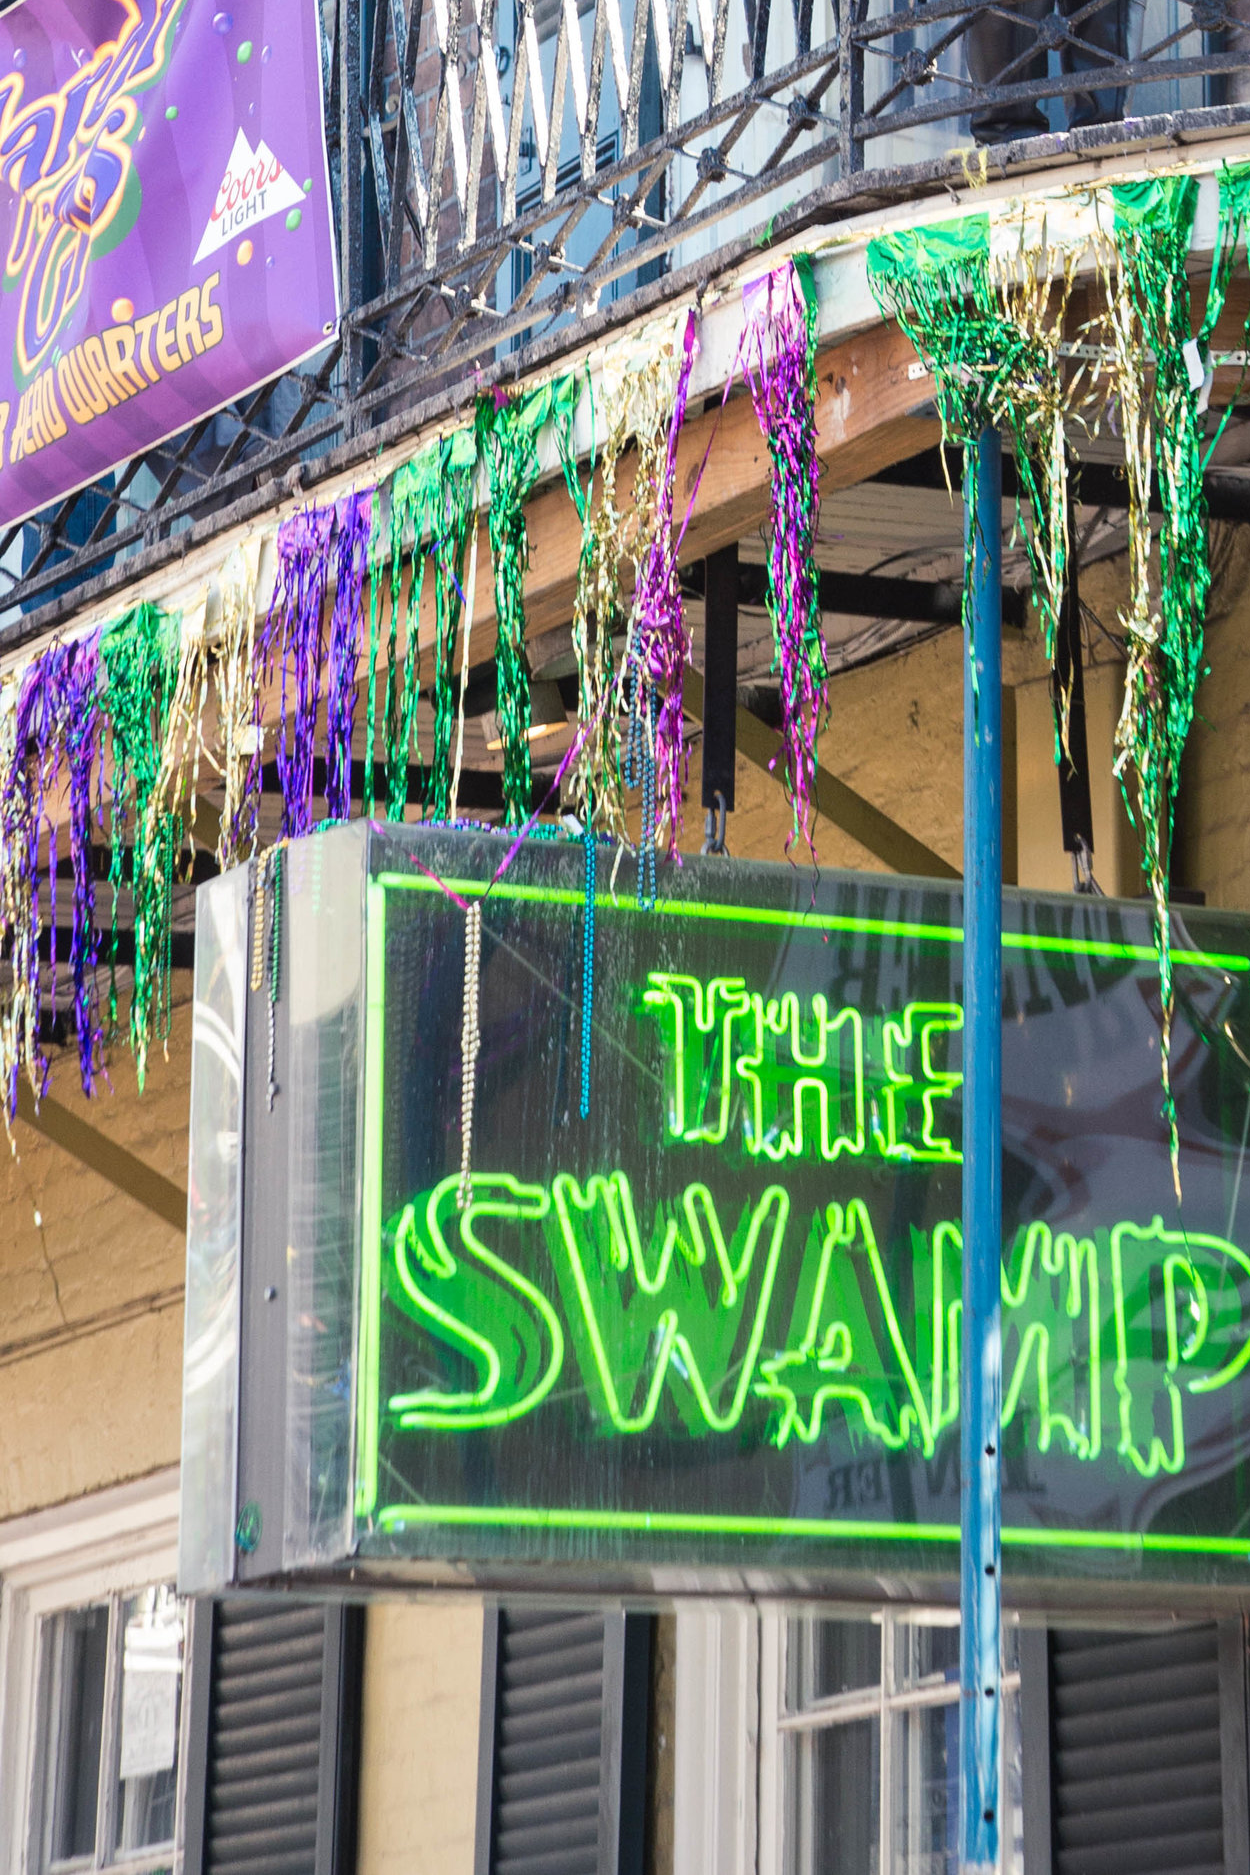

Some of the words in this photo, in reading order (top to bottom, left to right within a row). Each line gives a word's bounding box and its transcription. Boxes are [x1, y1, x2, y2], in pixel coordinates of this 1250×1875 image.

[209, 157, 284, 222] Coors
[221, 188, 267, 237] LIGHT
[9, 366, 68, 464] HEAD
[57, 270, 224, 425] QUARTERS
[643, 971, 965, 1163] THE
